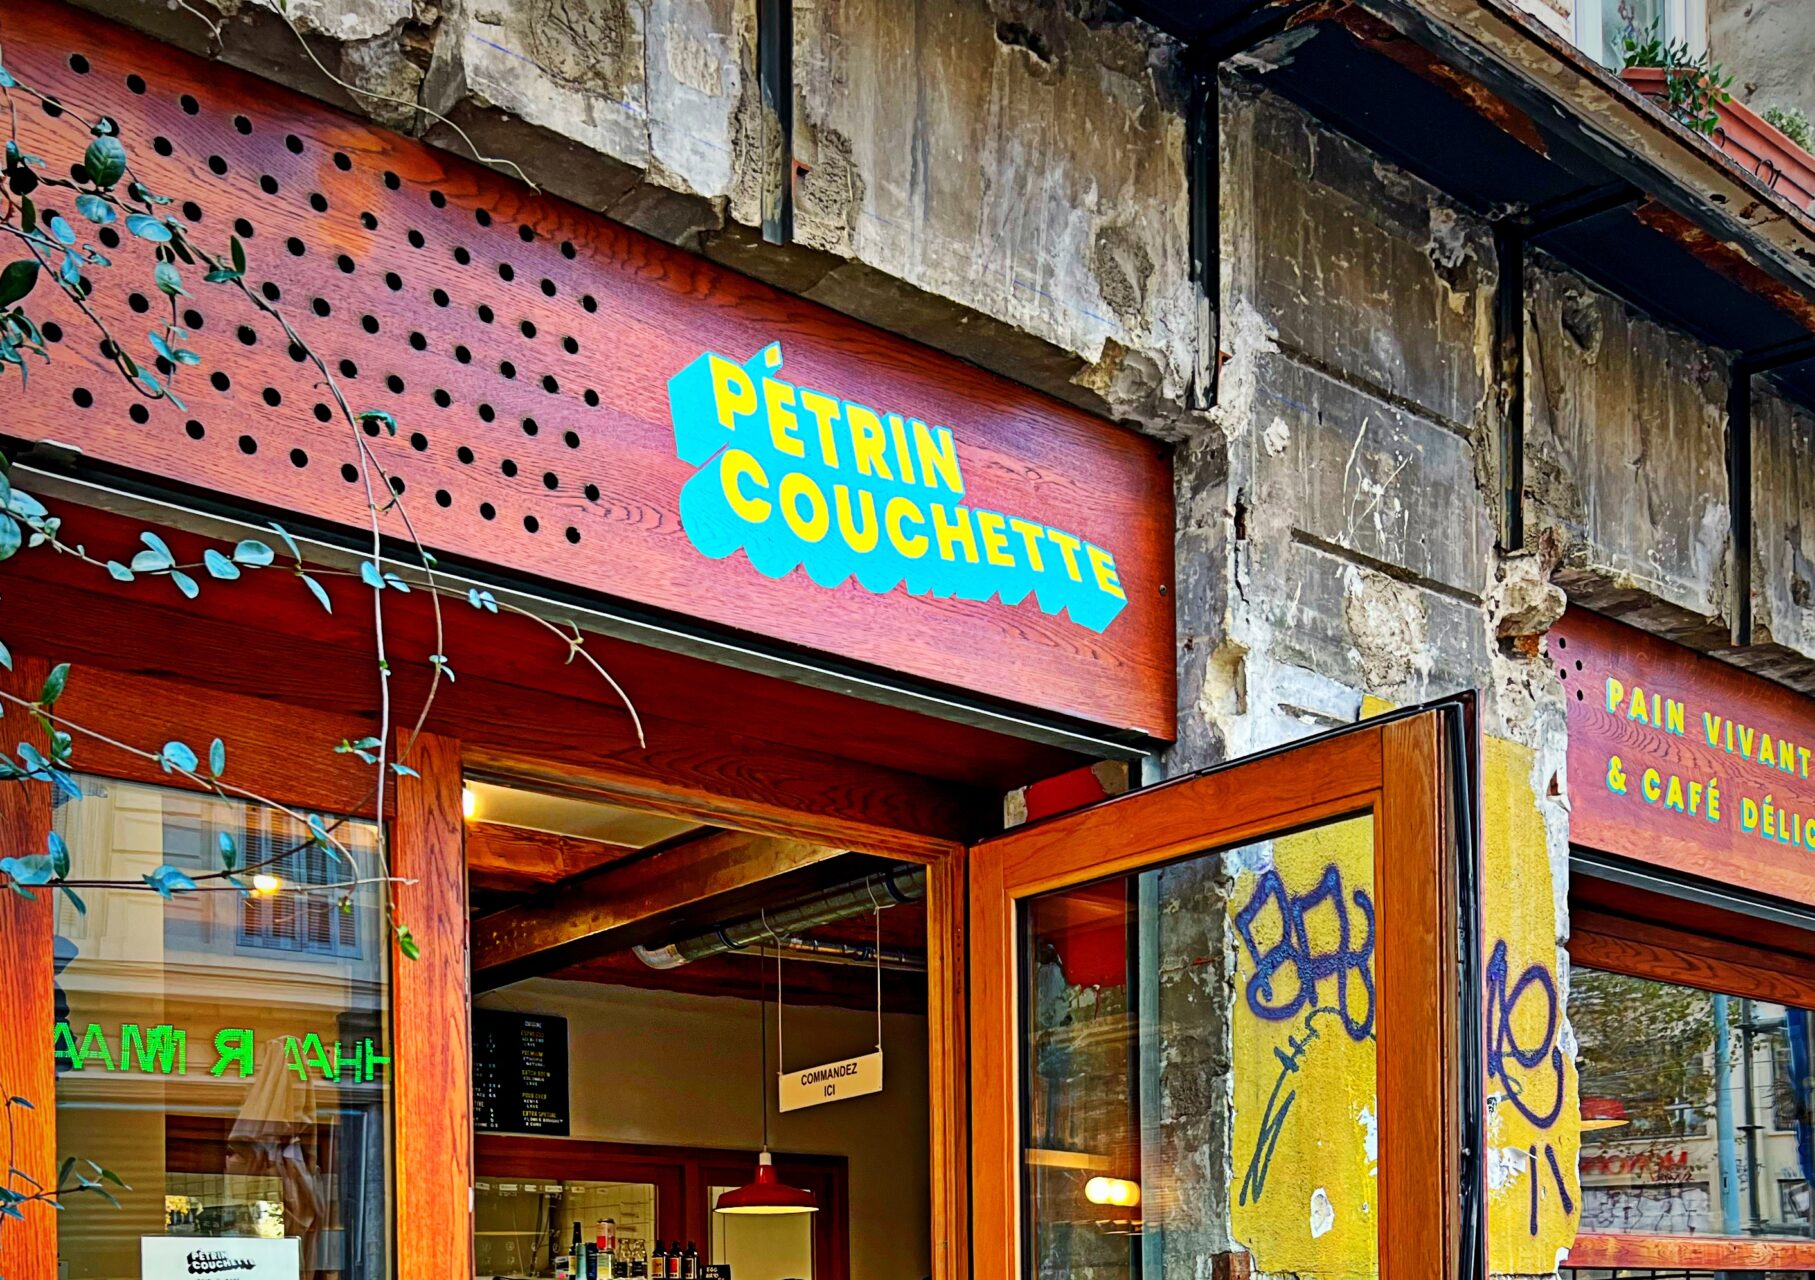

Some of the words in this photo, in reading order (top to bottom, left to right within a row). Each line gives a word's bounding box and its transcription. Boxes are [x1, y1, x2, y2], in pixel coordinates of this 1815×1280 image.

[708, 342, 963, 494] PÉTRIN
[719, 448, 1126, 600] COUCHETTE
[1606, 677, 1684, 736] PAIN
[1703, 711, 1812, 780] VIVANT
[1606, 756, 1627, 795] &
[1641, 768, 1720, 822] CAFÉ
[801, 1062, 858, 1086] COMMANDEZ
[824, 1084, 836, 1097] ICI
